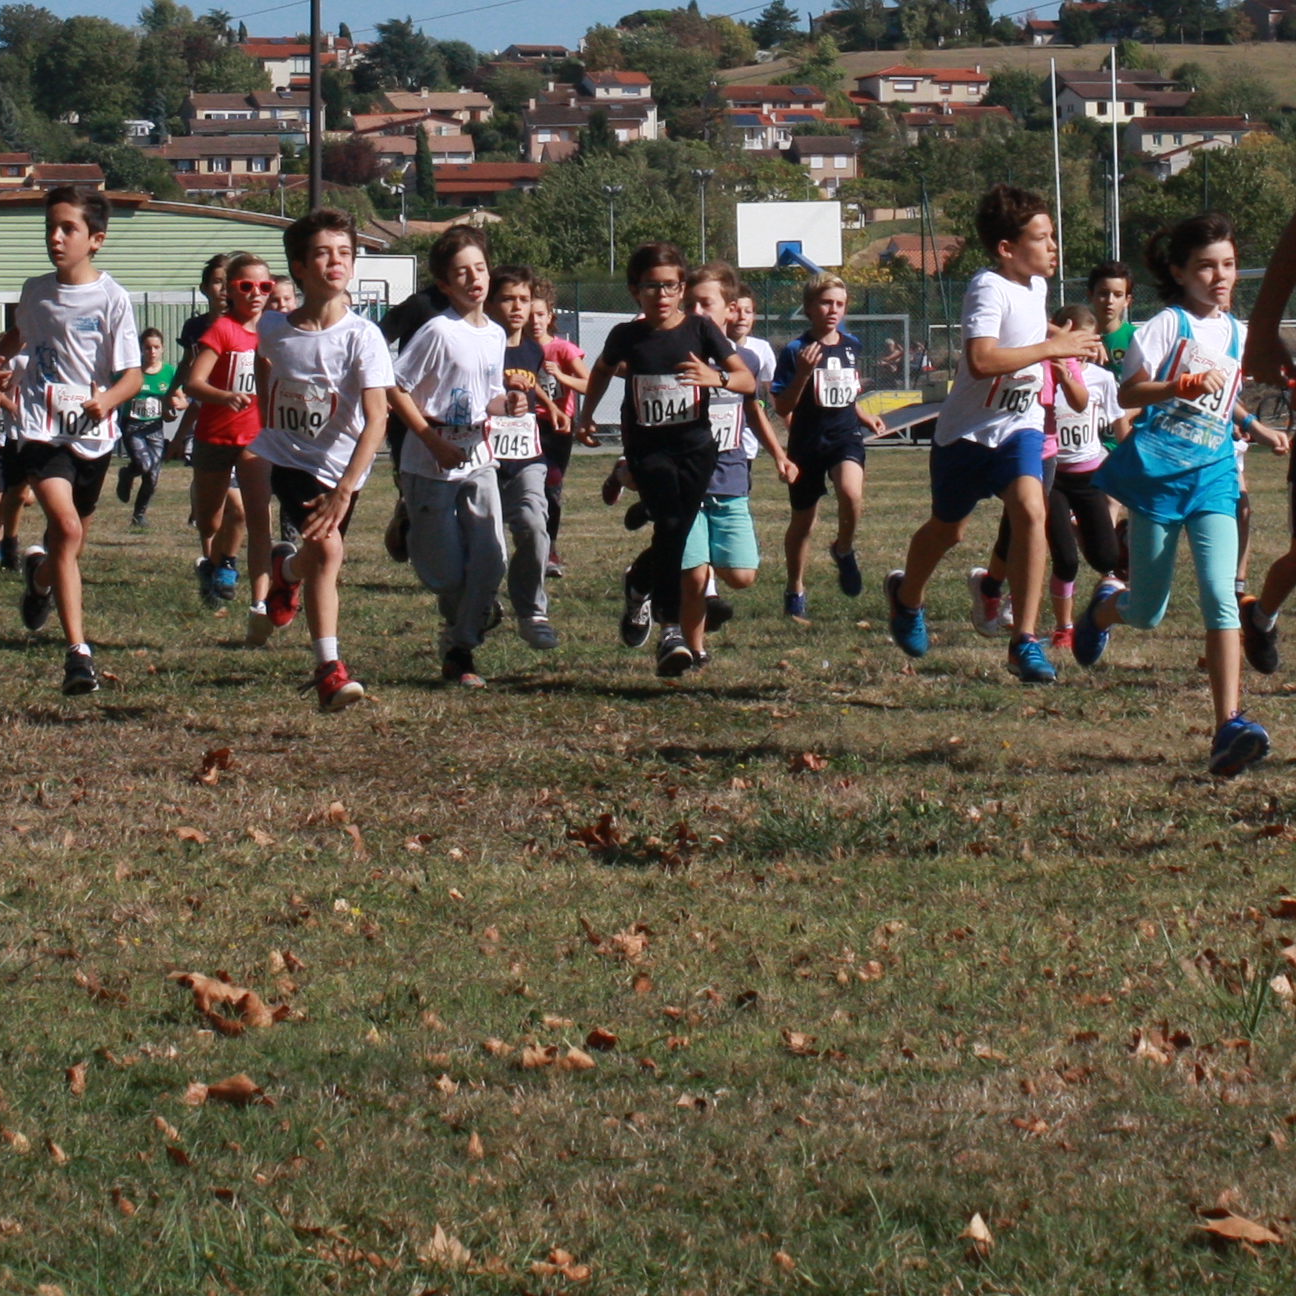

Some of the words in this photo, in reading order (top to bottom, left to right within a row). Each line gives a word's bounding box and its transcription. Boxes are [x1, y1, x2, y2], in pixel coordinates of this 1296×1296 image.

[239, 373, 255, 393] 10
[823, 387, 852, 405] 1032
[999, 388, 1032, 413] 105
[278, 406, 322, 434] 1049
[643, 398, 689, 423] 1044
[494, 434, 529, 456] 1045
[714, 426, 732, 448] 47
[1060, 424, 1089, 447] 060
